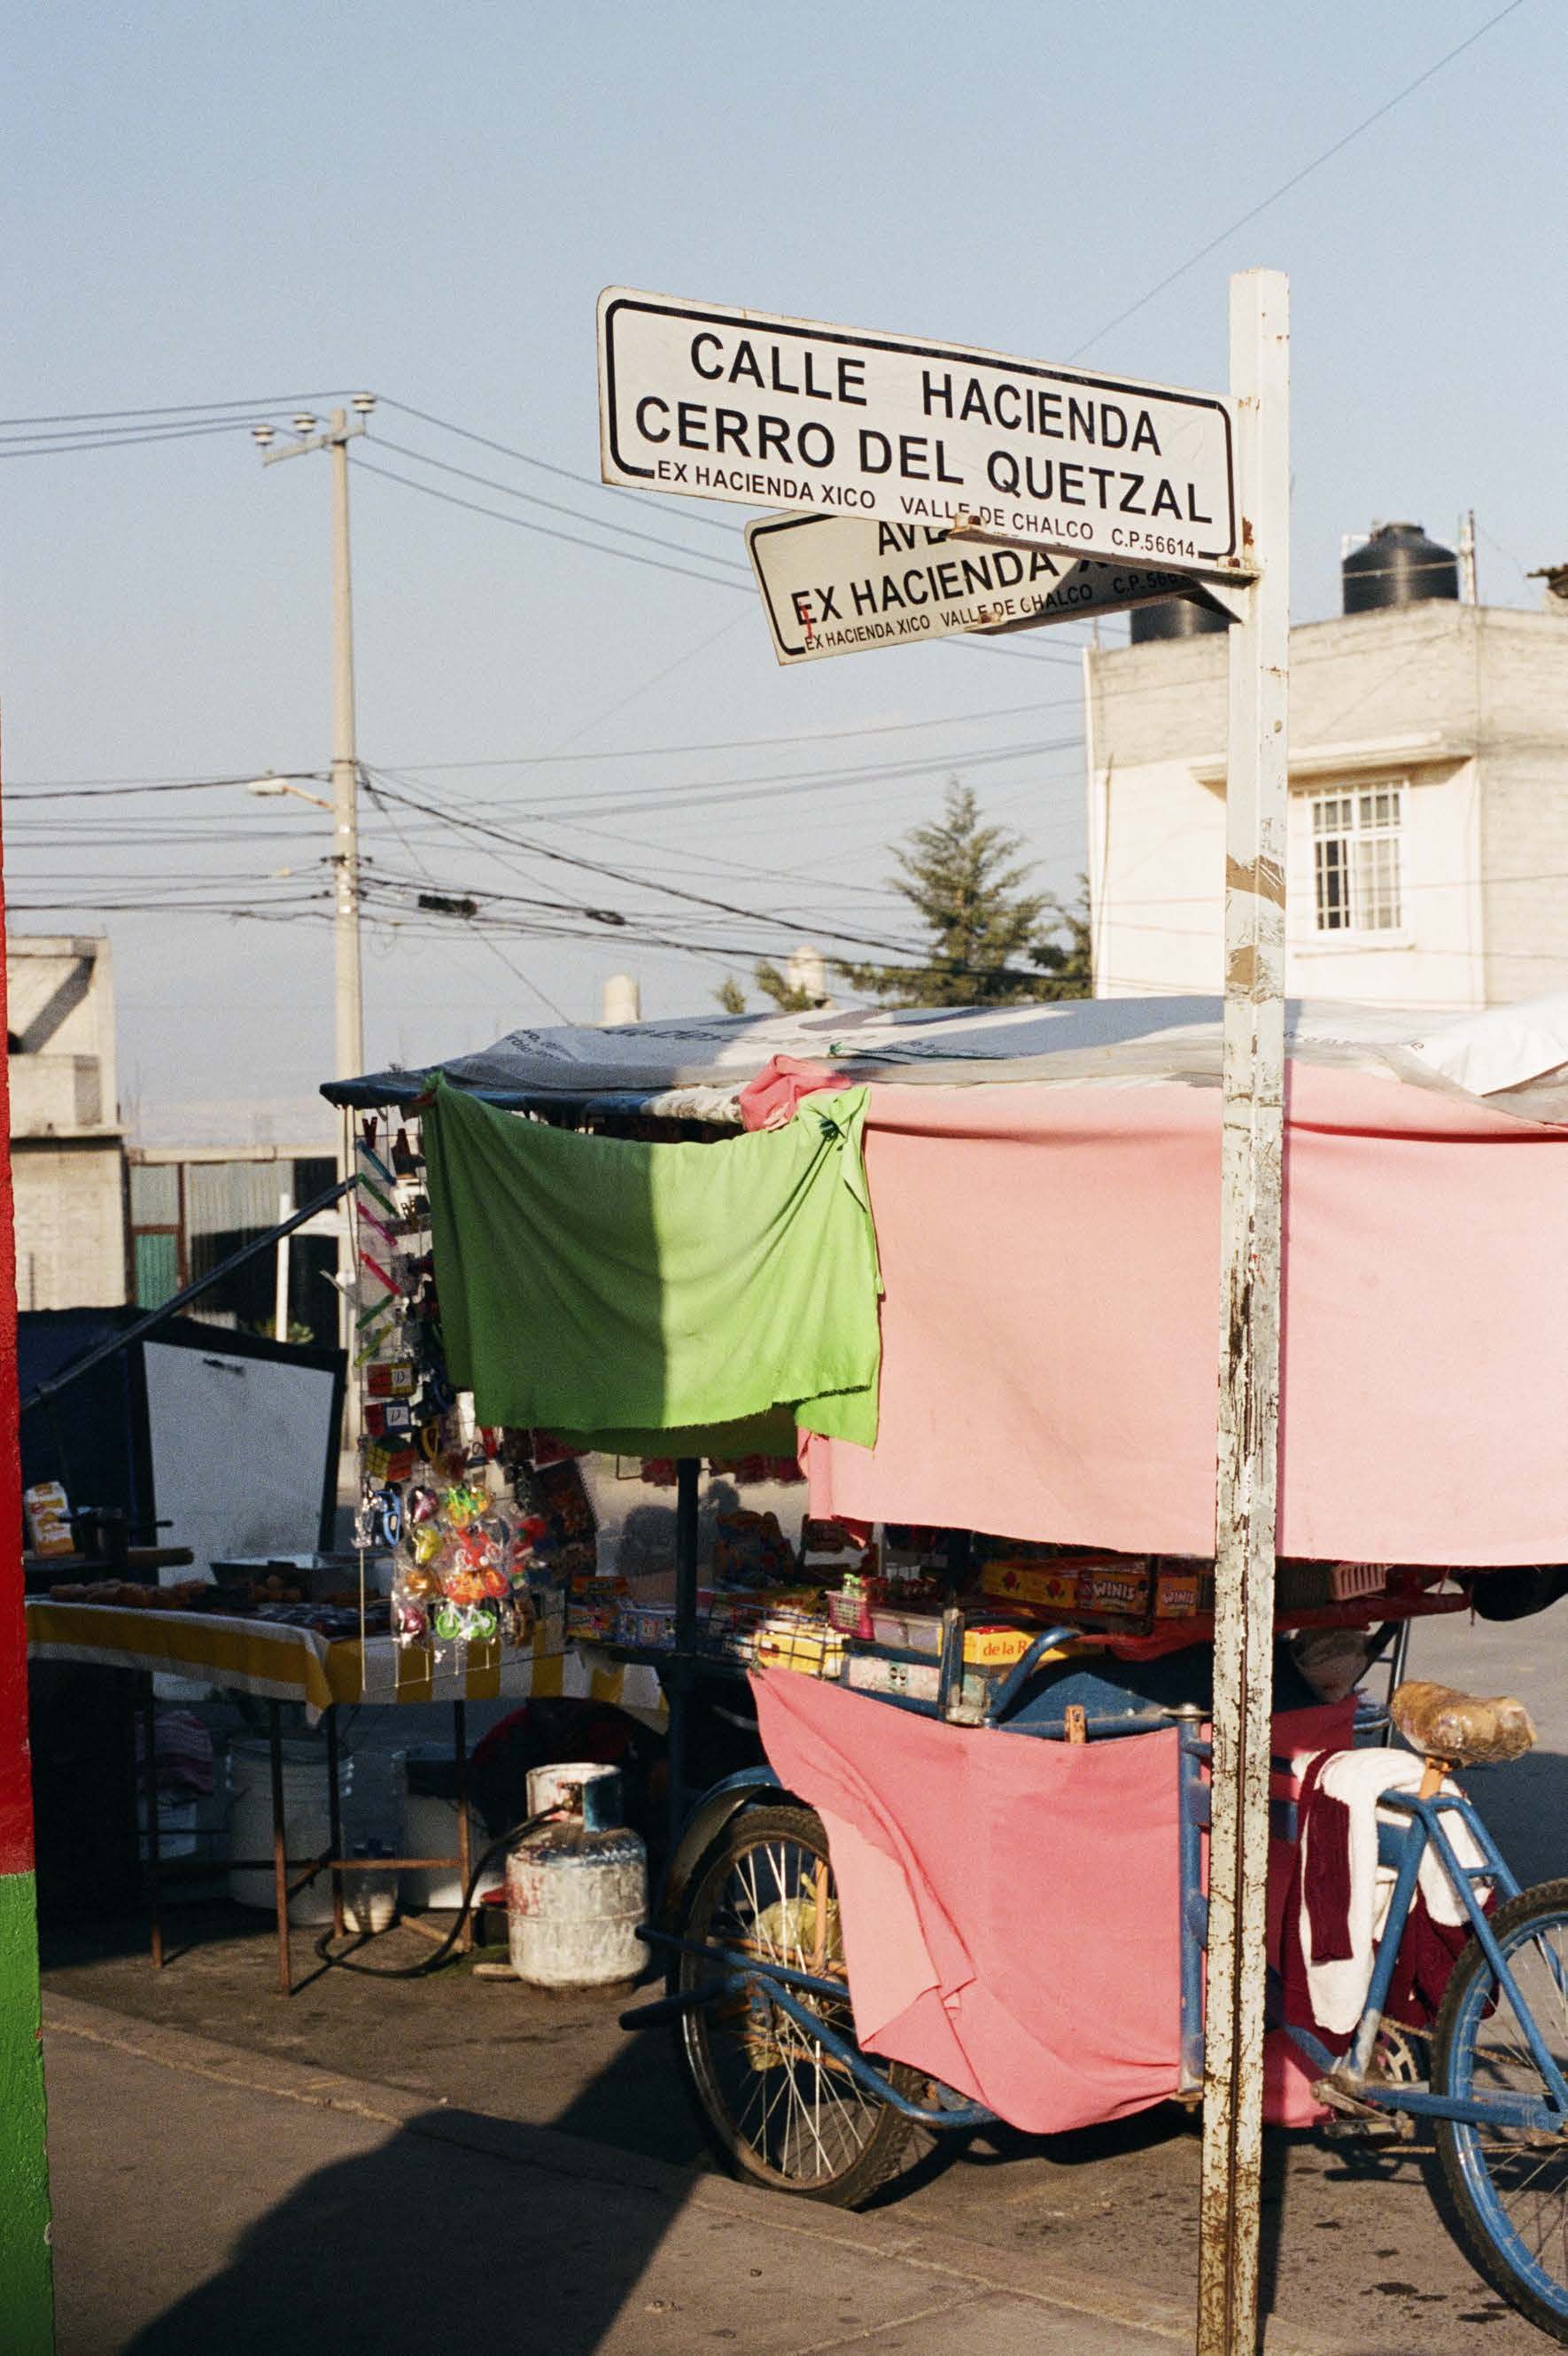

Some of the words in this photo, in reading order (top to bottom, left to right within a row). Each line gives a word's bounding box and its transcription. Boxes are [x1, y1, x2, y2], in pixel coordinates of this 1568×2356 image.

[690, 332, 867, 407] CALLE
[921, 369, 1162, 456] HACIENDA
[635, 395, 835, 469] CERRO
[858, 428, 965, 486] DEL
[986, 449, 1213, 525] QUETZAL
[657, 460, 688, 484] EX
[695, 466, 815, 502] HACIENDA
[821, 483, 876, 509] XICO
[980, 505, 1005, 527] DE
[1012, 512, 1094, 540] CHALCO
[1111, 527, 1195, 558] C.P.56614
[790, 585, 843, 626] EX
[850, 548, 1061, 617] HACIENDA
[804, 634, 824, 651] EX
[825, 621, 895, 649] HACIENDA
[898, 613, 931, 636] XICO
[993, 598, 1017, 617] DE
[1020, 583, 1094, 614] CHALCO
[983, 1642, 999, 1656] de
[1002, 1641, 1014, 1655] la
